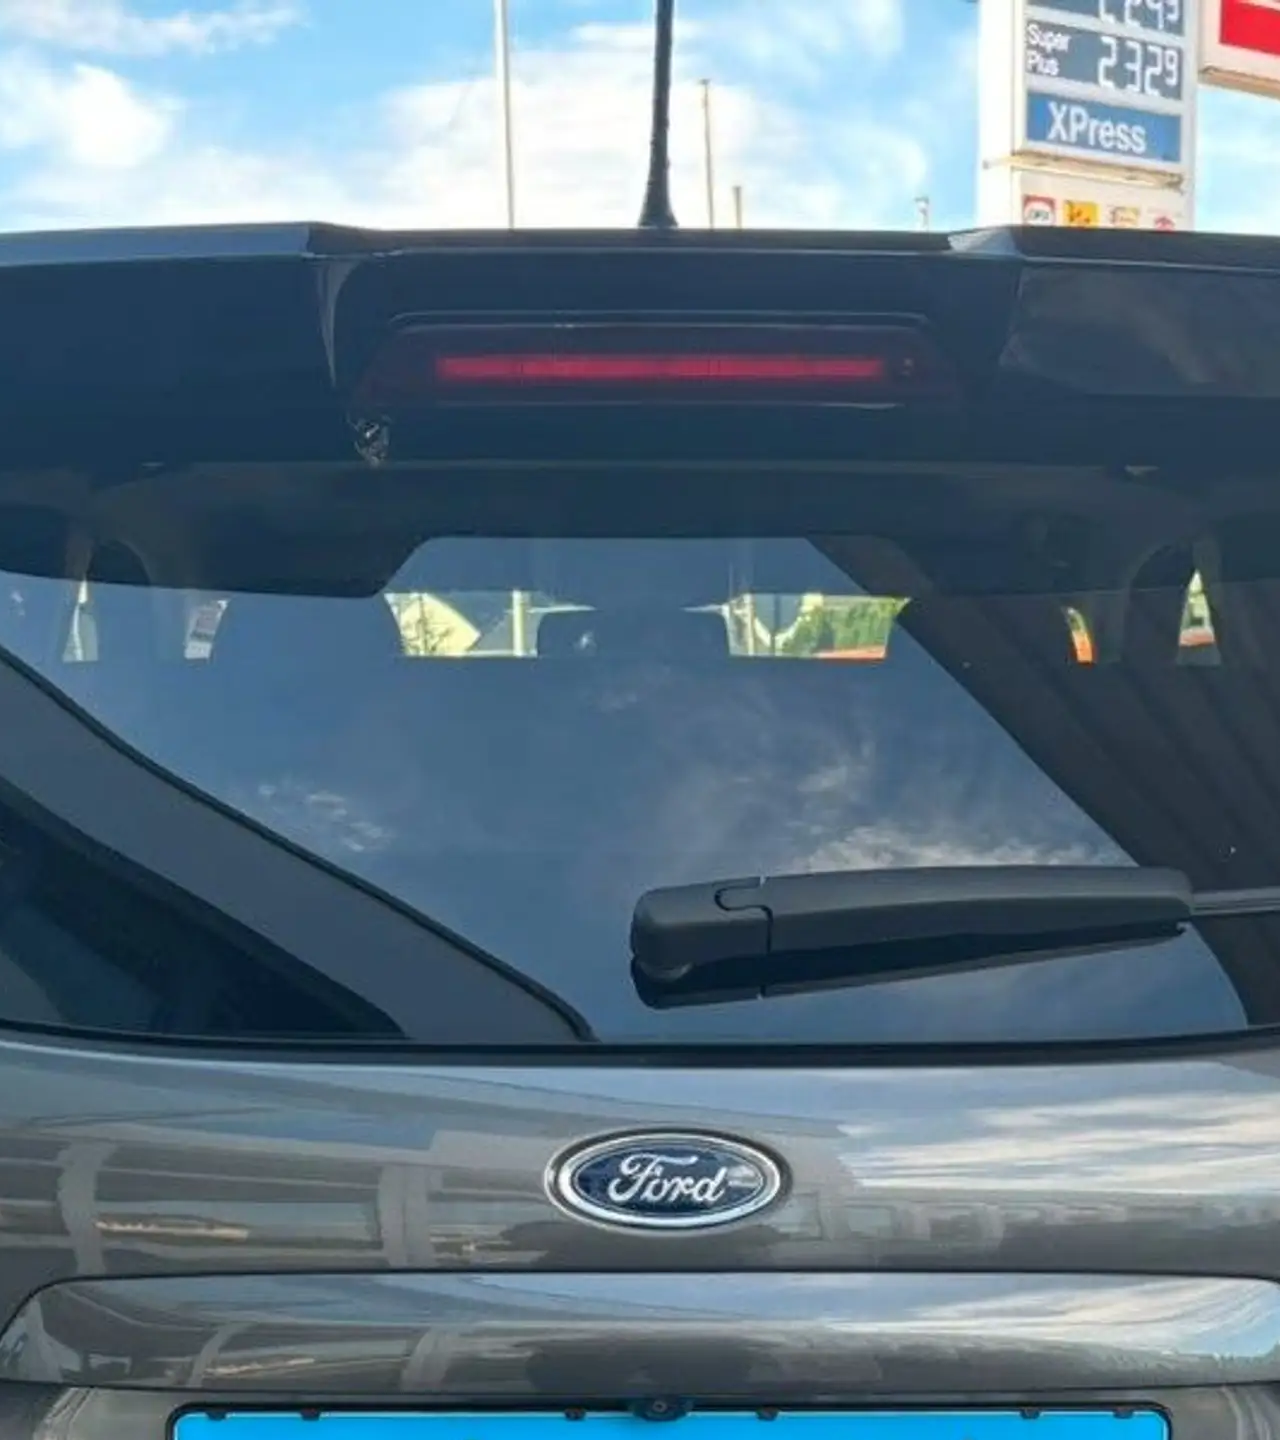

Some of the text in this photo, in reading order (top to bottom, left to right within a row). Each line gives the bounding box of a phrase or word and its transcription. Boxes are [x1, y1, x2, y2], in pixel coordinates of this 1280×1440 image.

[1027, 23, 1071, 52] Super
[1027, 50, 1060, 76] Plus
[1047, 102, 1147, 155] XPress
[608, 1153, 728, 1203] Ford
